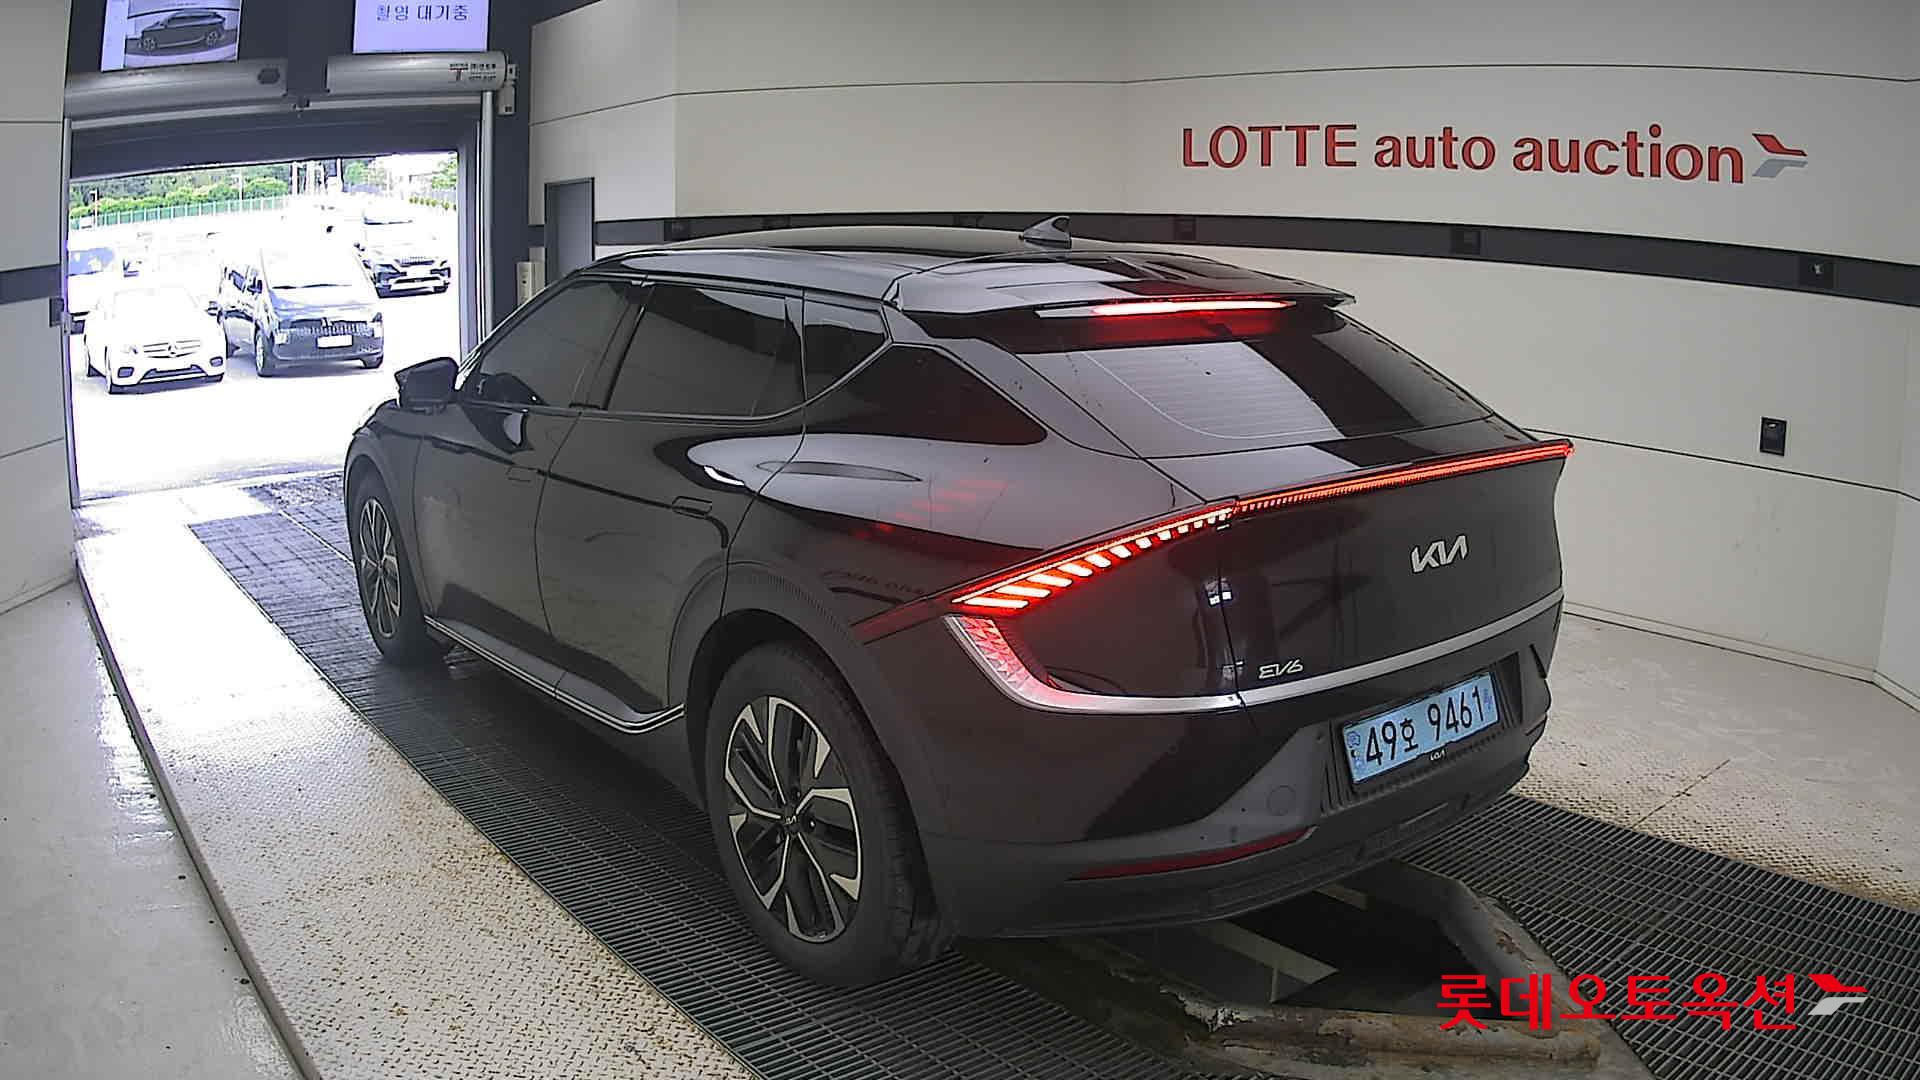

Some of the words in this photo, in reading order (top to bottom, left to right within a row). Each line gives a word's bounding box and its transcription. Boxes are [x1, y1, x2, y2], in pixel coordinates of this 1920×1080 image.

[417, 4, 470, 21] 대기중
[1182, 123, 1358, 169] LOTTE
[1373, 125, 1497, 171] auto
[1512, 123, 1745, 185] auction
[1410, 534, 1468, 574] KIA
[1258, 659, 1304, 680] EV6
[1365, 717, 1419, 766] 49호
[1426, 685, 1485, 742] 9461
